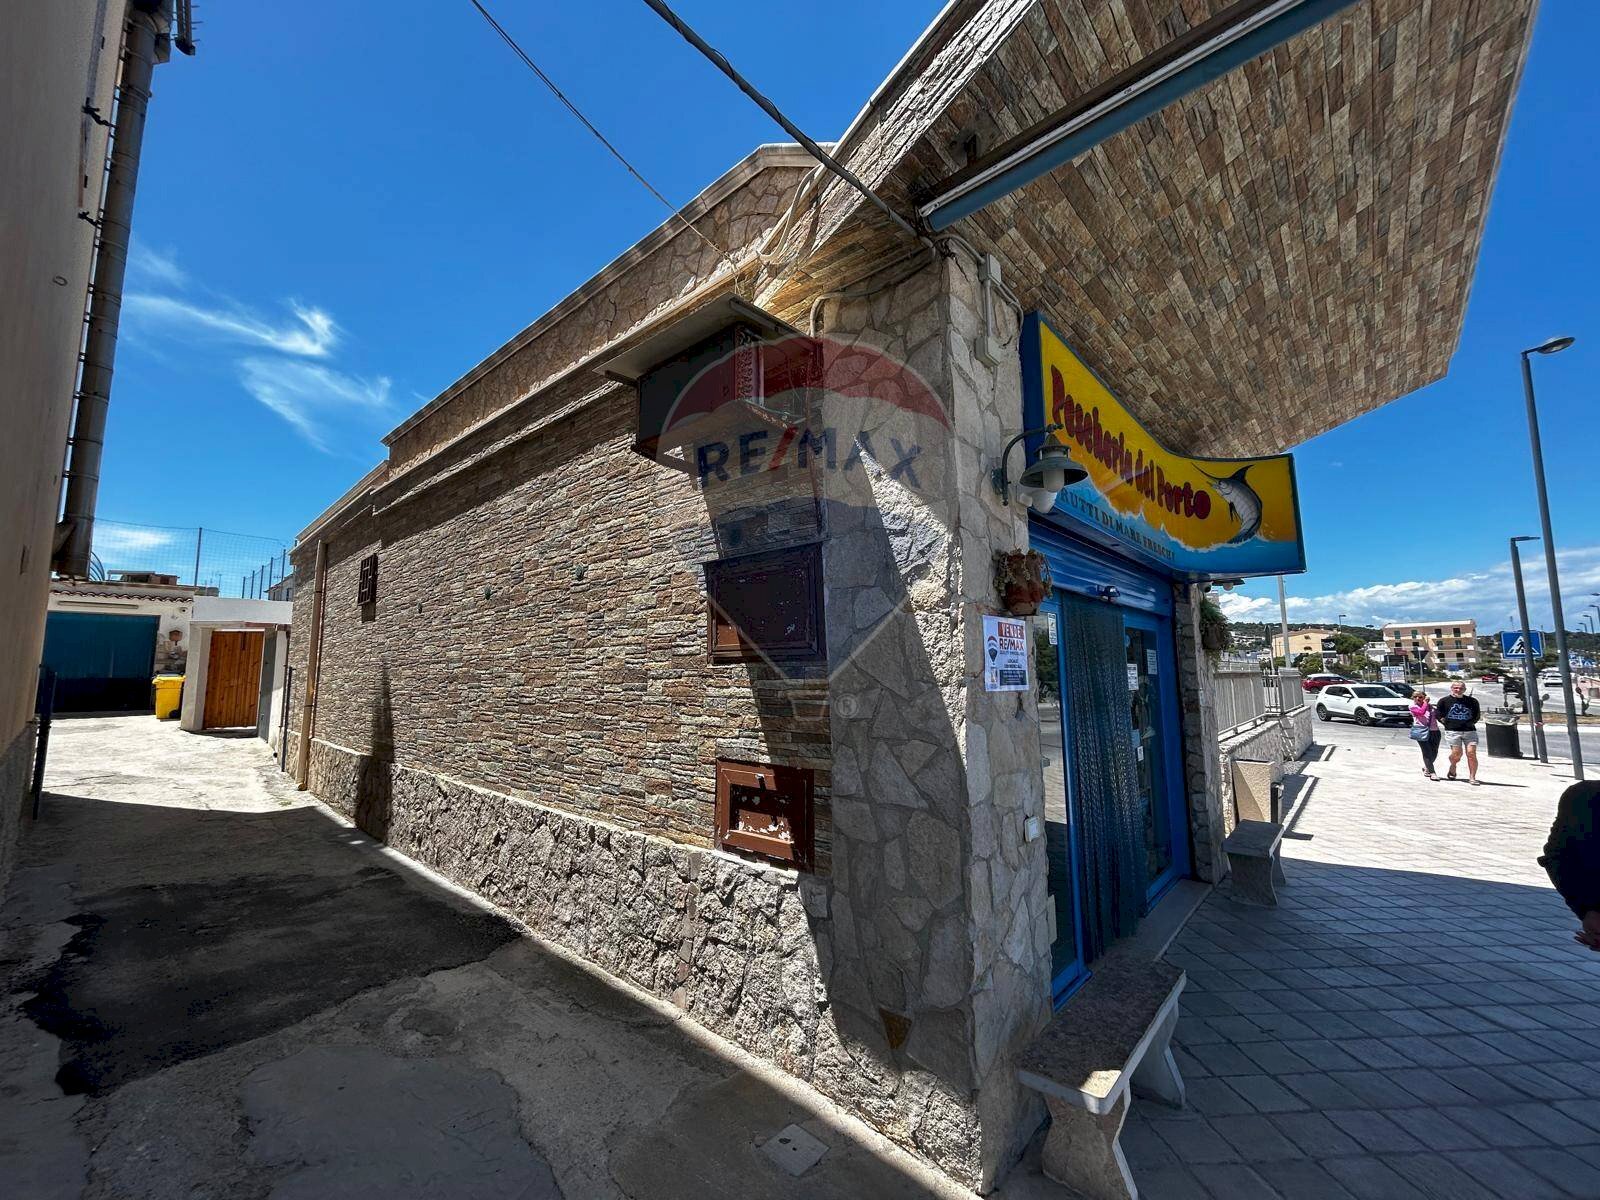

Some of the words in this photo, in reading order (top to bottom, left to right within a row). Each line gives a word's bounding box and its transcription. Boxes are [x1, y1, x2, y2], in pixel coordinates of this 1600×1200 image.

[1135, 449, 1155, 502] del
[1157, 465, 1211, 520] Porto
[1059, 489, 1100, 522] RUTTI
[1115, 519, 1142, 545] MARE
[999, 638, 1024, 650] RE/MAX
